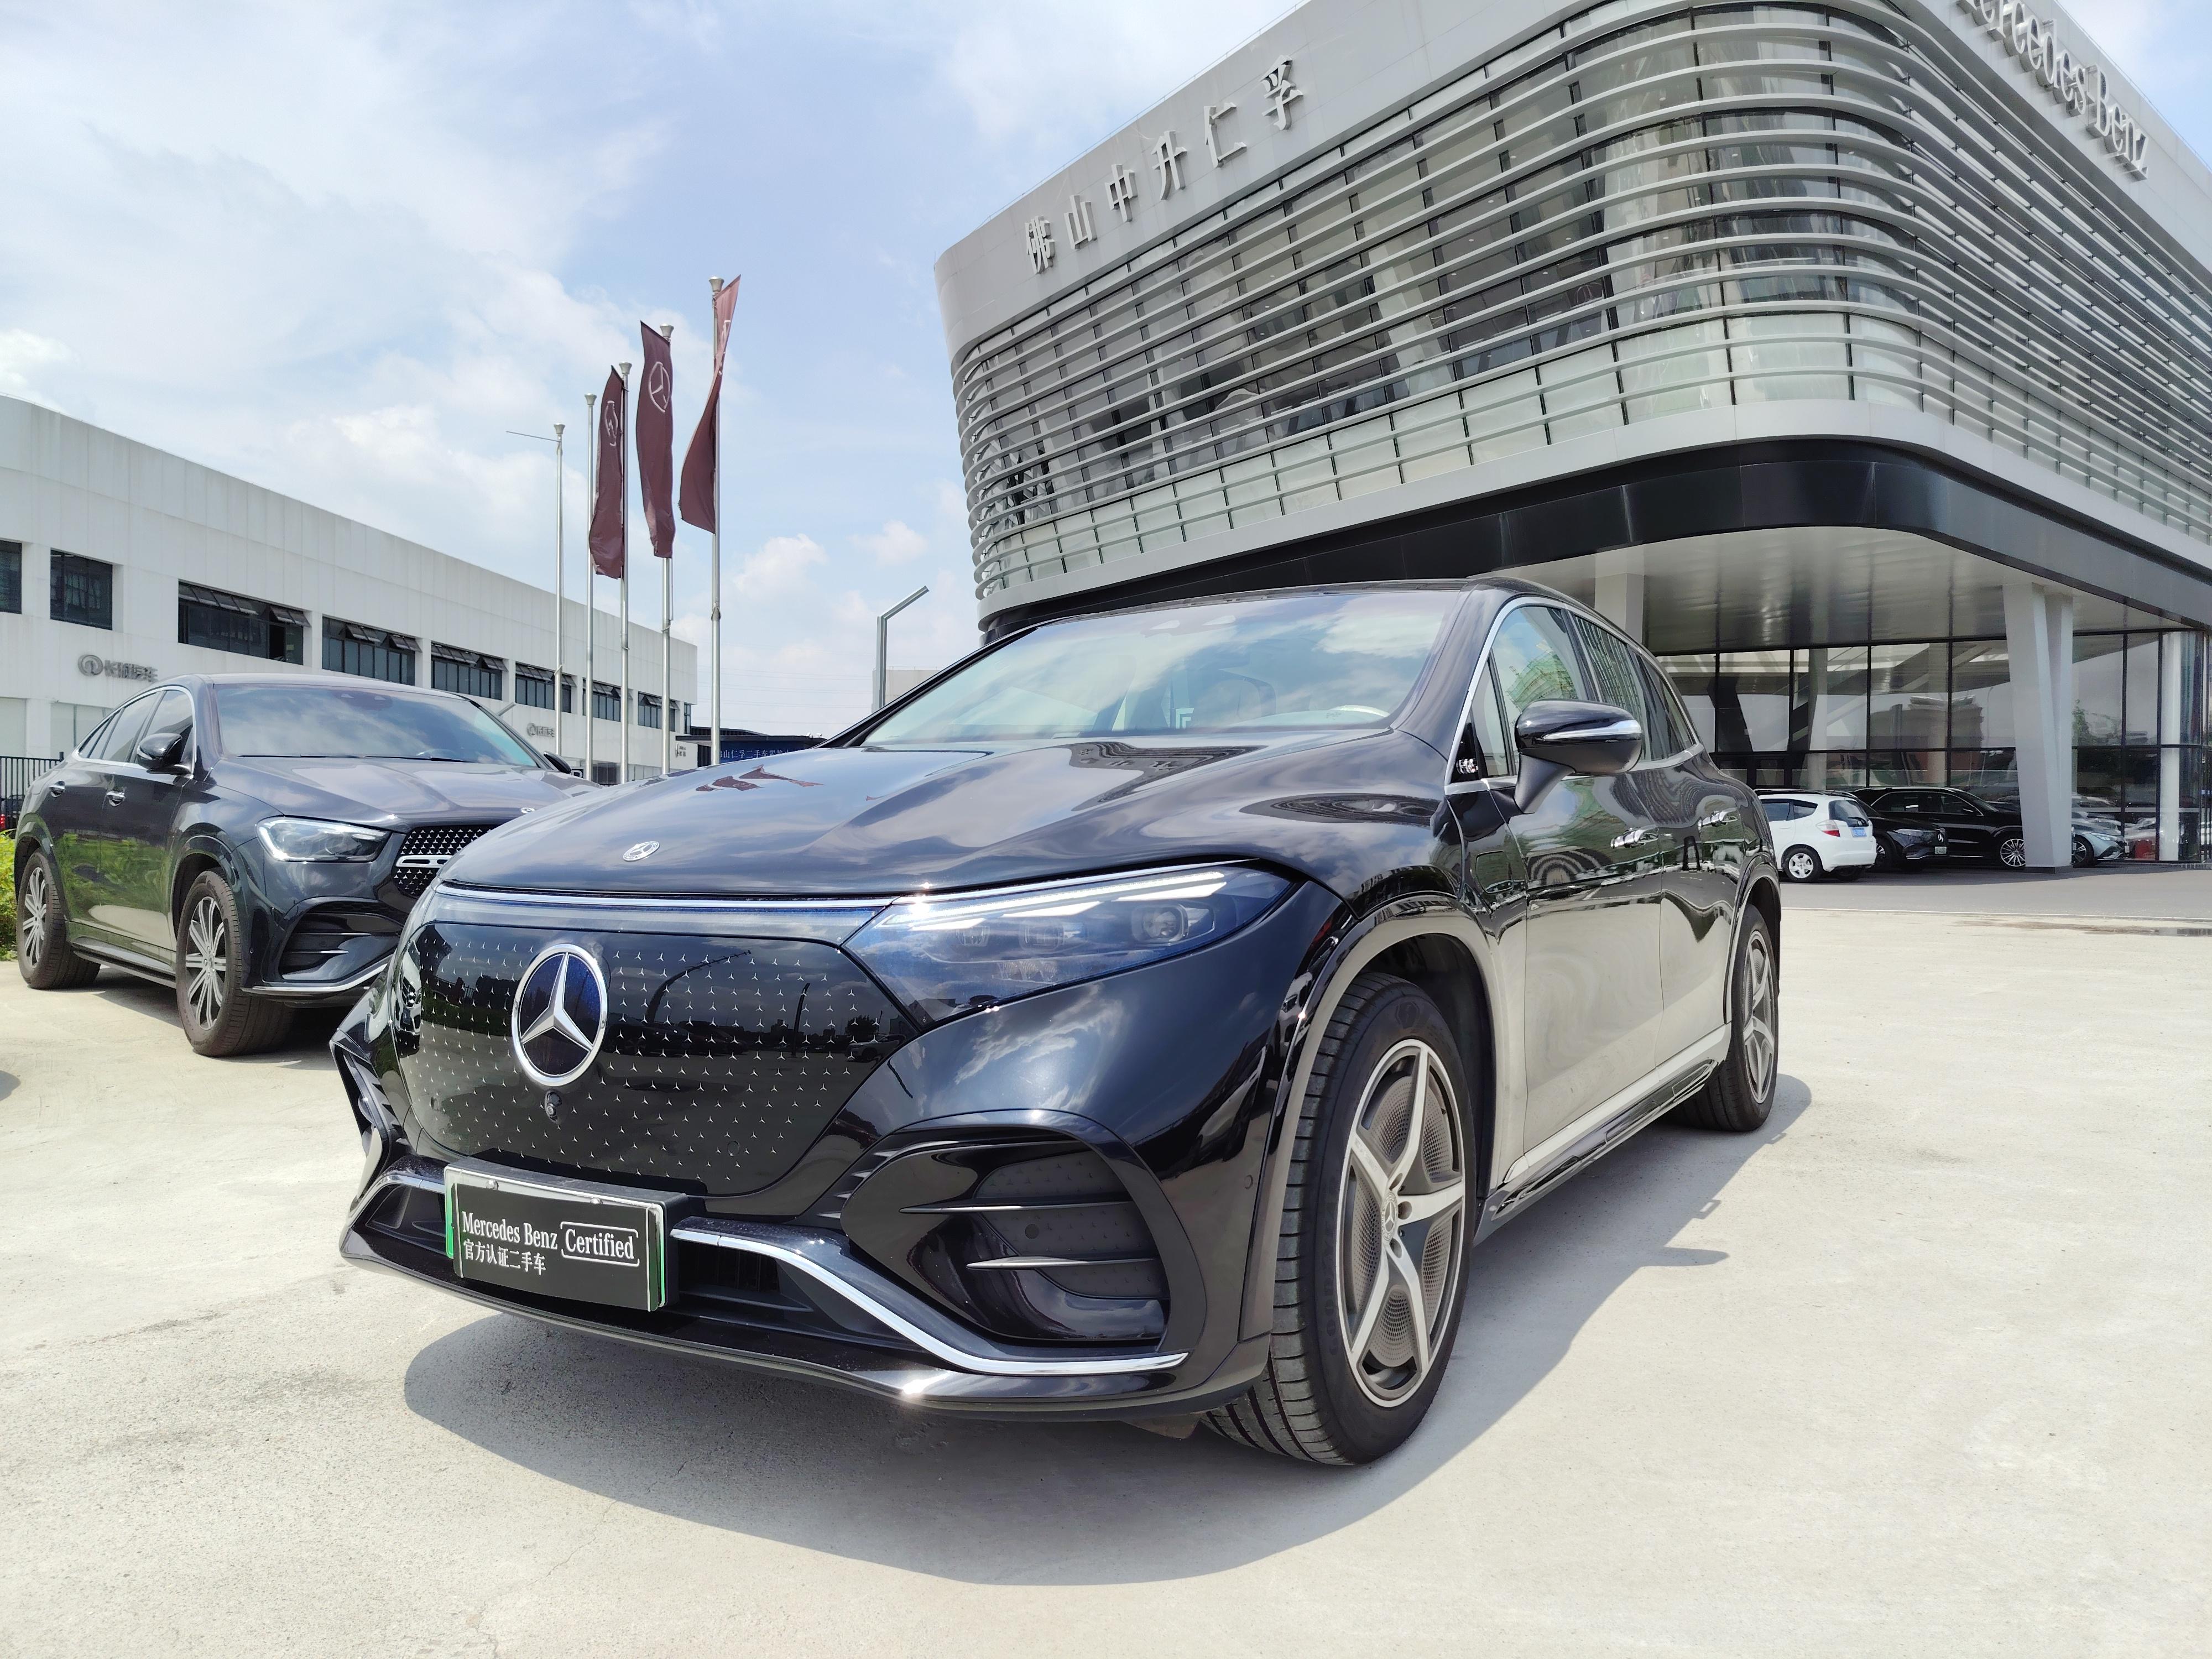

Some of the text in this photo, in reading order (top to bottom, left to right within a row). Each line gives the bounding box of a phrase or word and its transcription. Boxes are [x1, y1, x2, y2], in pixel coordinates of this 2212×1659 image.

[1965, 0, 2150, 179] rcedes-Benz
[1025, 55, 1303, 274] 佛山中升仁孚
[462, 1211, 634, 1259] Mercedes Benz Certified
[463, 1238, 546, 1275] 官方认证二手车
